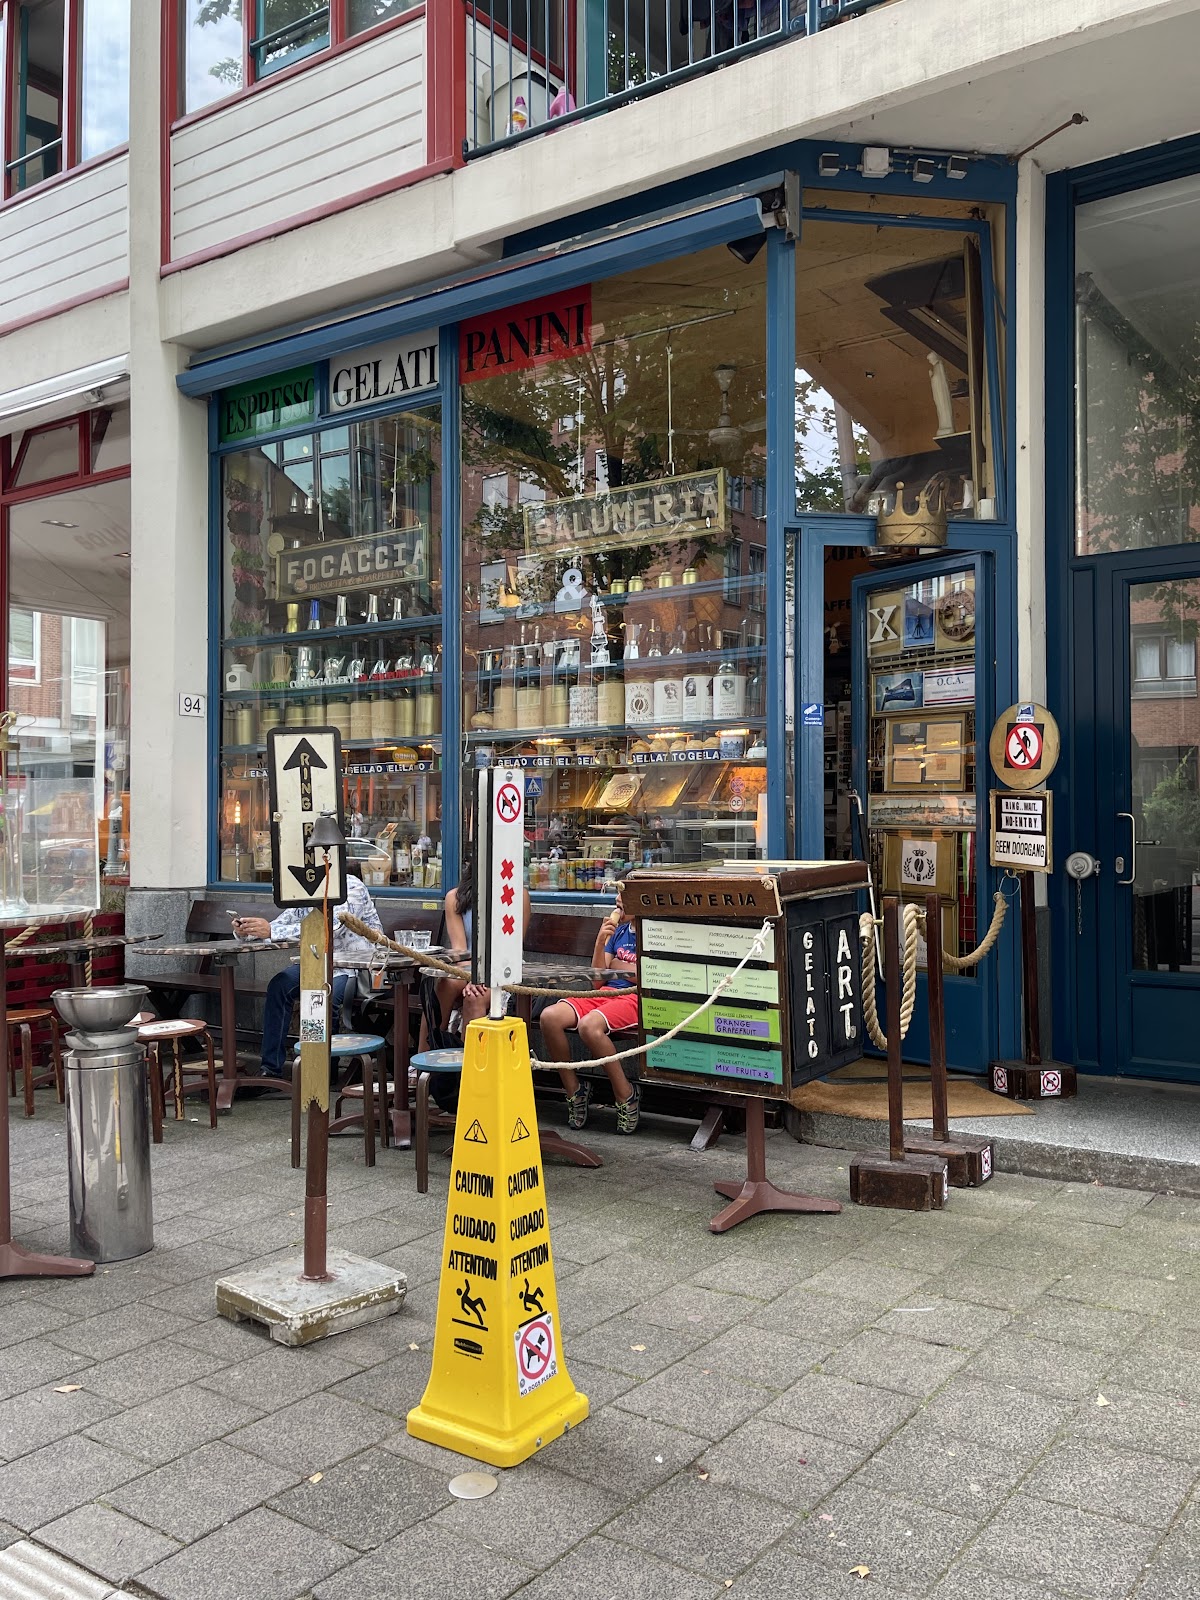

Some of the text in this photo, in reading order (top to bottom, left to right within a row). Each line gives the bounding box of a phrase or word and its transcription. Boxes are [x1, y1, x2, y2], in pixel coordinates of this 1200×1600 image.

[464, 303, 586, 374] PANINI
[333, 344, 438, 407] GELATI
[535, 488, 718, 545] SALUMERIA
[287, 540, 424, 584] FOCACCIA
[936, 676, 964, 687] O.C.A.
[183, 697, 201, 714] 94
[300, 752, 312, 810] RING
[303, 823, 316, 882] RNG
[995, 840, 1045, 858] GEEN DOORGANG
[640, 892, 757, 908] GELATERIA
[803, 931, 819, 1059] GELATO
[716, 1017, 751, 1028] ORANGE
[716, 1025, 757, 1036] GRAPEFRUIT
[715, 1064, 730, 1073] MIX
[735, 1066, 757, 1077] FRUIT
[455, 1169, 494, 1198] CAUTION
[507, 1165, 539, 1197] CAUTION
[453, 1214, 496, 1243] CUIDADO
[509, 1208, 544, 1241] CUIDADO
[448, 1249, 498, 1281] ATTENTION
[510, 1242, 549, 1279] ATTENTION
[520, 1369, 557, 1396] NO DOGS PLEASE
